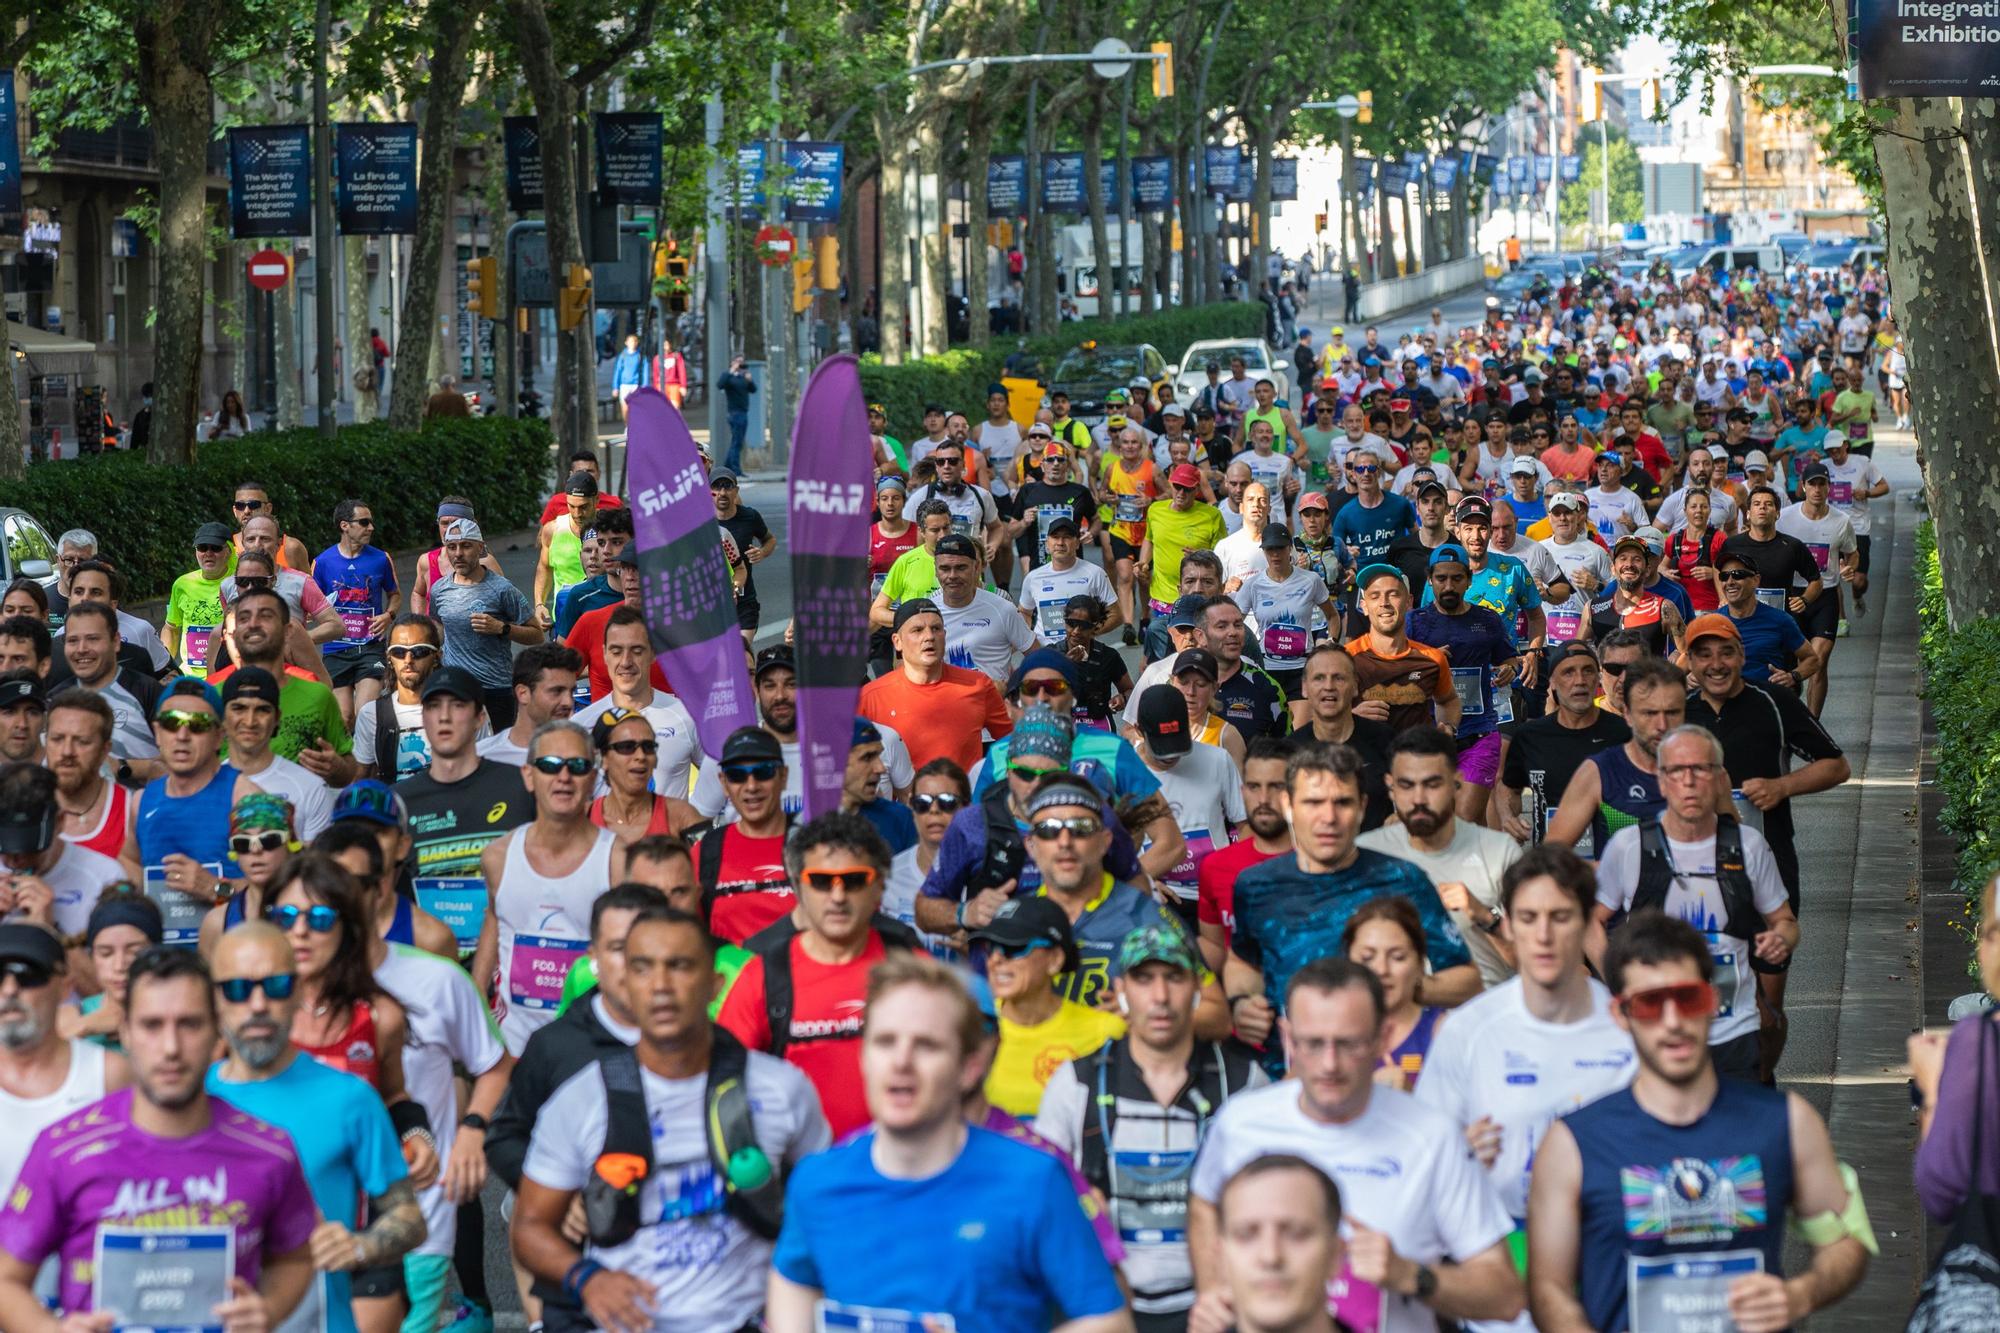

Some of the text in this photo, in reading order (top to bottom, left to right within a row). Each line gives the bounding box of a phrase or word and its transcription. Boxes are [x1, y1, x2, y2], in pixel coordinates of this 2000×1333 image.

[1898, 0, 2000, 22] Integrati
[244, 172, 295, 182] The World's
[353, 171, 400, 181] La fira de
[246, 182, 293, 193] Leading AV
[242, 191, 297, 201] and Systems
[353, 193, 401, 203] més gran
[246, 201, 295, 212] Integration
[356, 202, 372, 212] del
[1358, 533, 1372, 544] La
[101, 1177, 183, 1219] ALL
